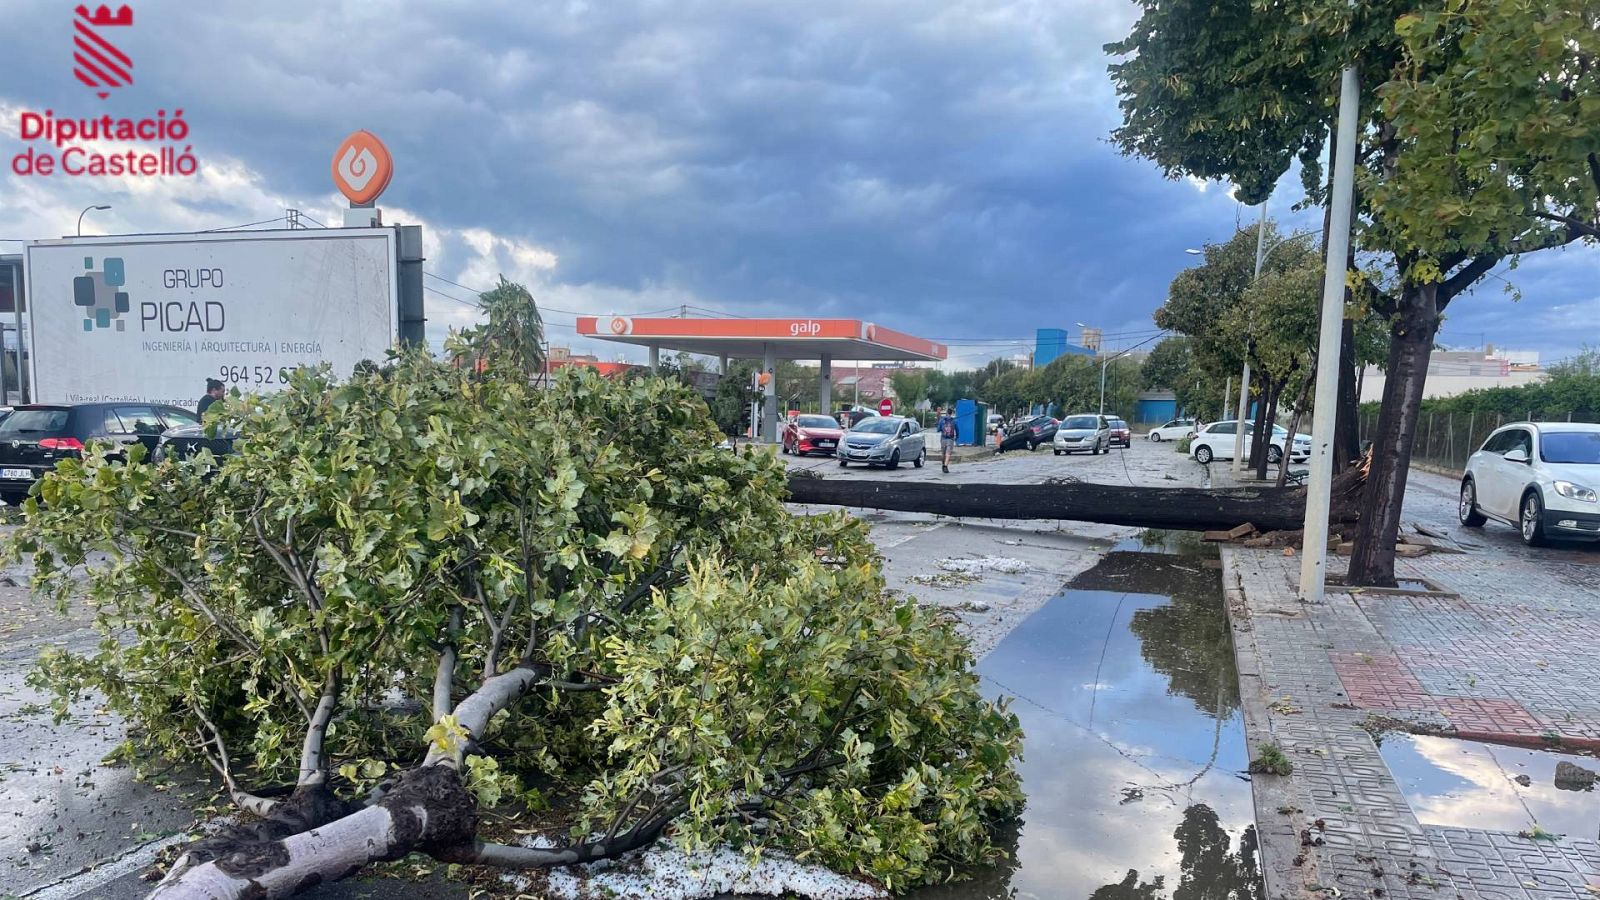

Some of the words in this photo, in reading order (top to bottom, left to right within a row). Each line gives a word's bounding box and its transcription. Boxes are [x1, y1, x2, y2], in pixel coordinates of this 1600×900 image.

[163, 268, 224, 289] GRUPO
[140, 301, 225, 332] PICAD
[790, 320, 821, 336] galp
[142, 340, 192, 353] INGENIERÍA
[200, 340, 271, 353] ARQUITECTURA
[281, 340, 322, 354] ENERGÍA
[220, 365, 249, 384] 964
[254, 366, 274, 384] 52
